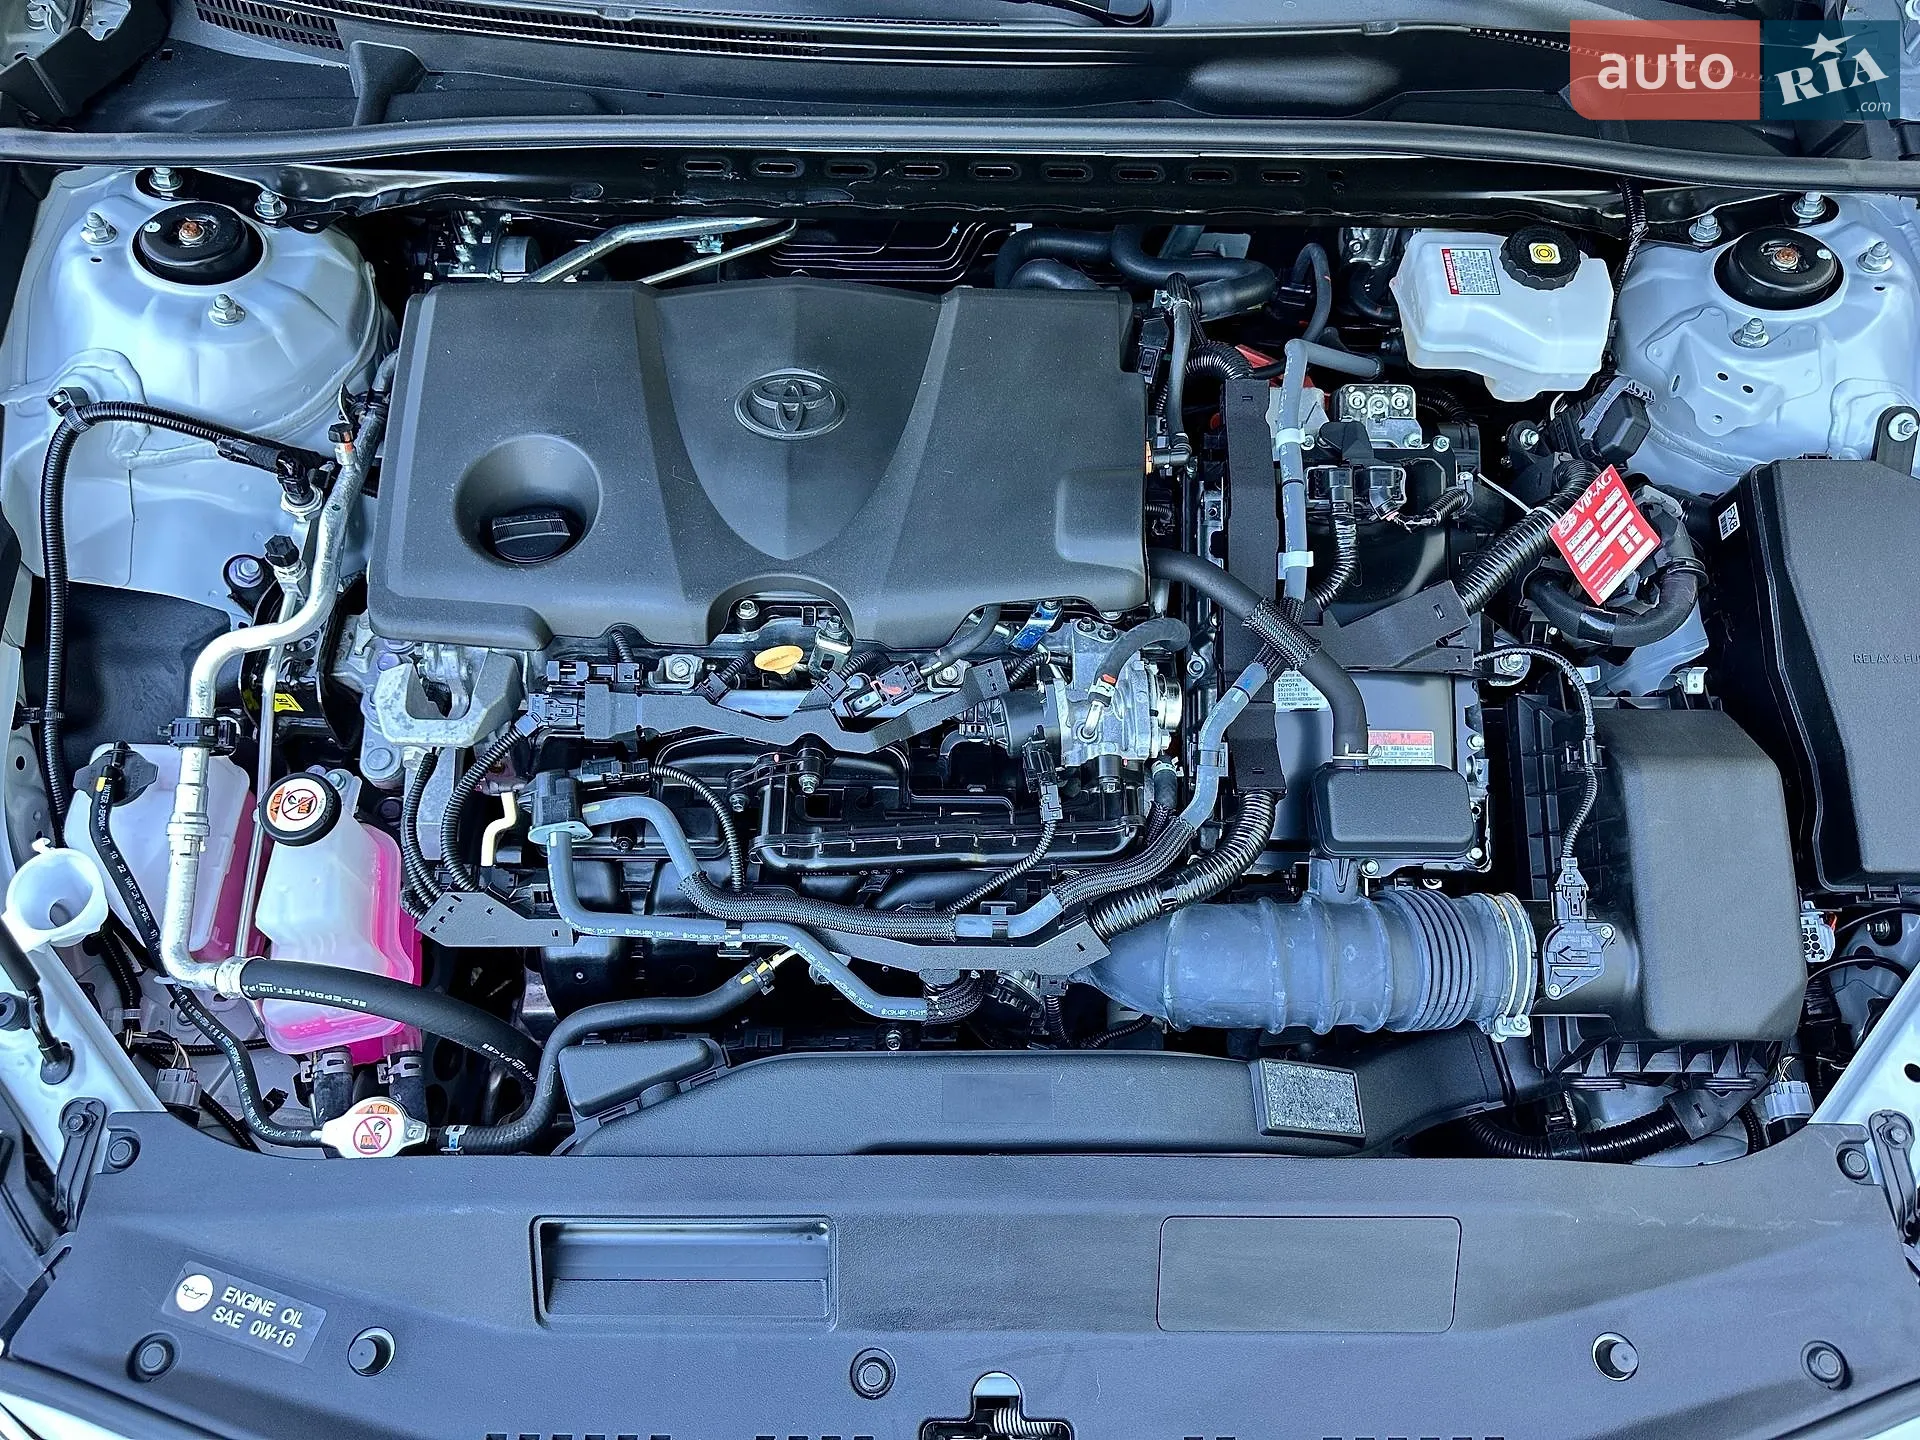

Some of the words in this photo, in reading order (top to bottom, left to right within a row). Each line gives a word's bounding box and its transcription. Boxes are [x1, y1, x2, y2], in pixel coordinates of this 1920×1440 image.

[1574, 471, 1613, 514] VIP-AG
[1726, 505, 1738, 530] FX8
[1853, 653, 1890, 664] RELAY
[1903, 653, 1920, 665] FU
[117, 864, 127, 874] 22
[221, 1286, 277, 1318] ENGINE
[281, 1308, 303, 1329] OIL
[212, 1306, 245, 1329] SAE
[249, 1320, 297, 1348] 0W-16
